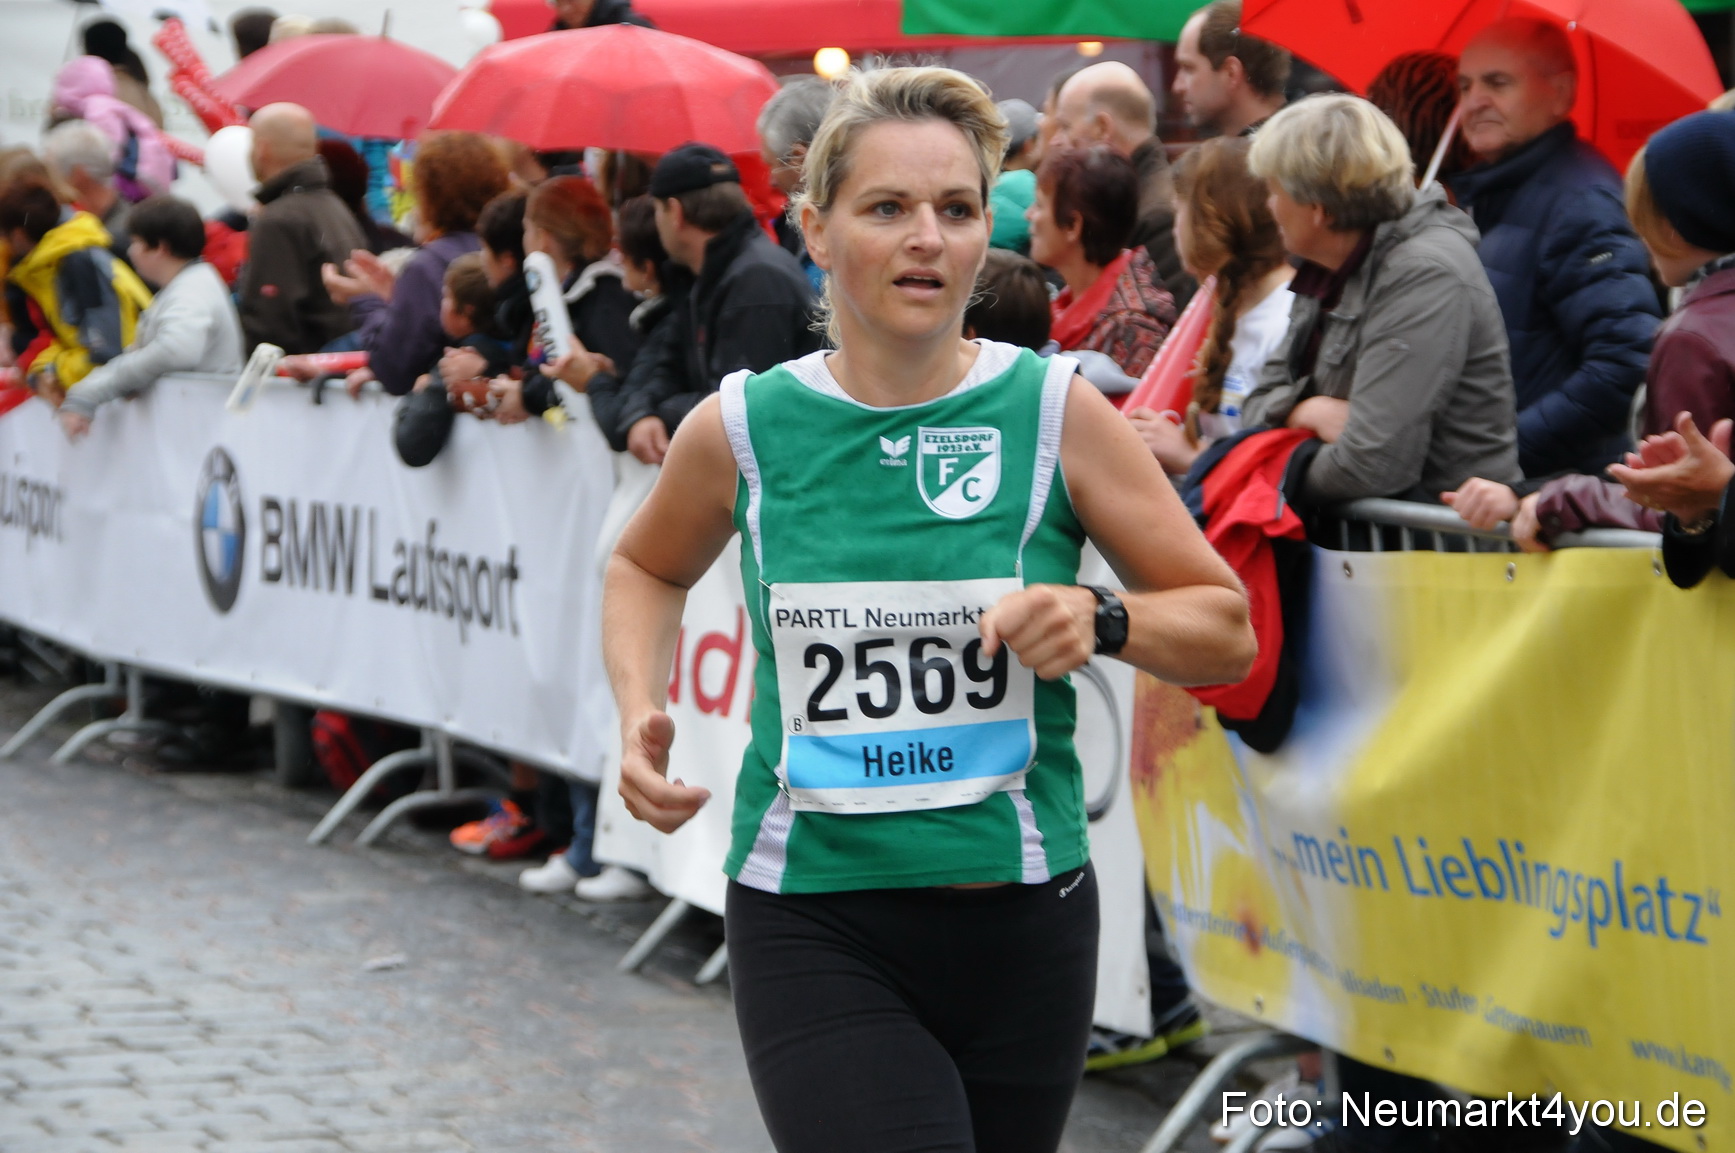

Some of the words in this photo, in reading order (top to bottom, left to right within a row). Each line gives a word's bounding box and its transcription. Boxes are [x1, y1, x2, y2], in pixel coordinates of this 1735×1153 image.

[924, 433, 995, 443] EZELSDORF
[937, 443, 962, 452] 1923
[938, 457, 959, 486] F
[962, 477, 982, 502] C
[260, 496, 359, 597] BMW
[368, 507, 520, 647] Laufsport
[776, 608, 857, 629] PARTL
[865, 606, 986, 628] Neumarkt
[803, 636, 1009, 722] 2569
[793, 718, 803, 731] B
[862, 742, 955, 778] Heike
